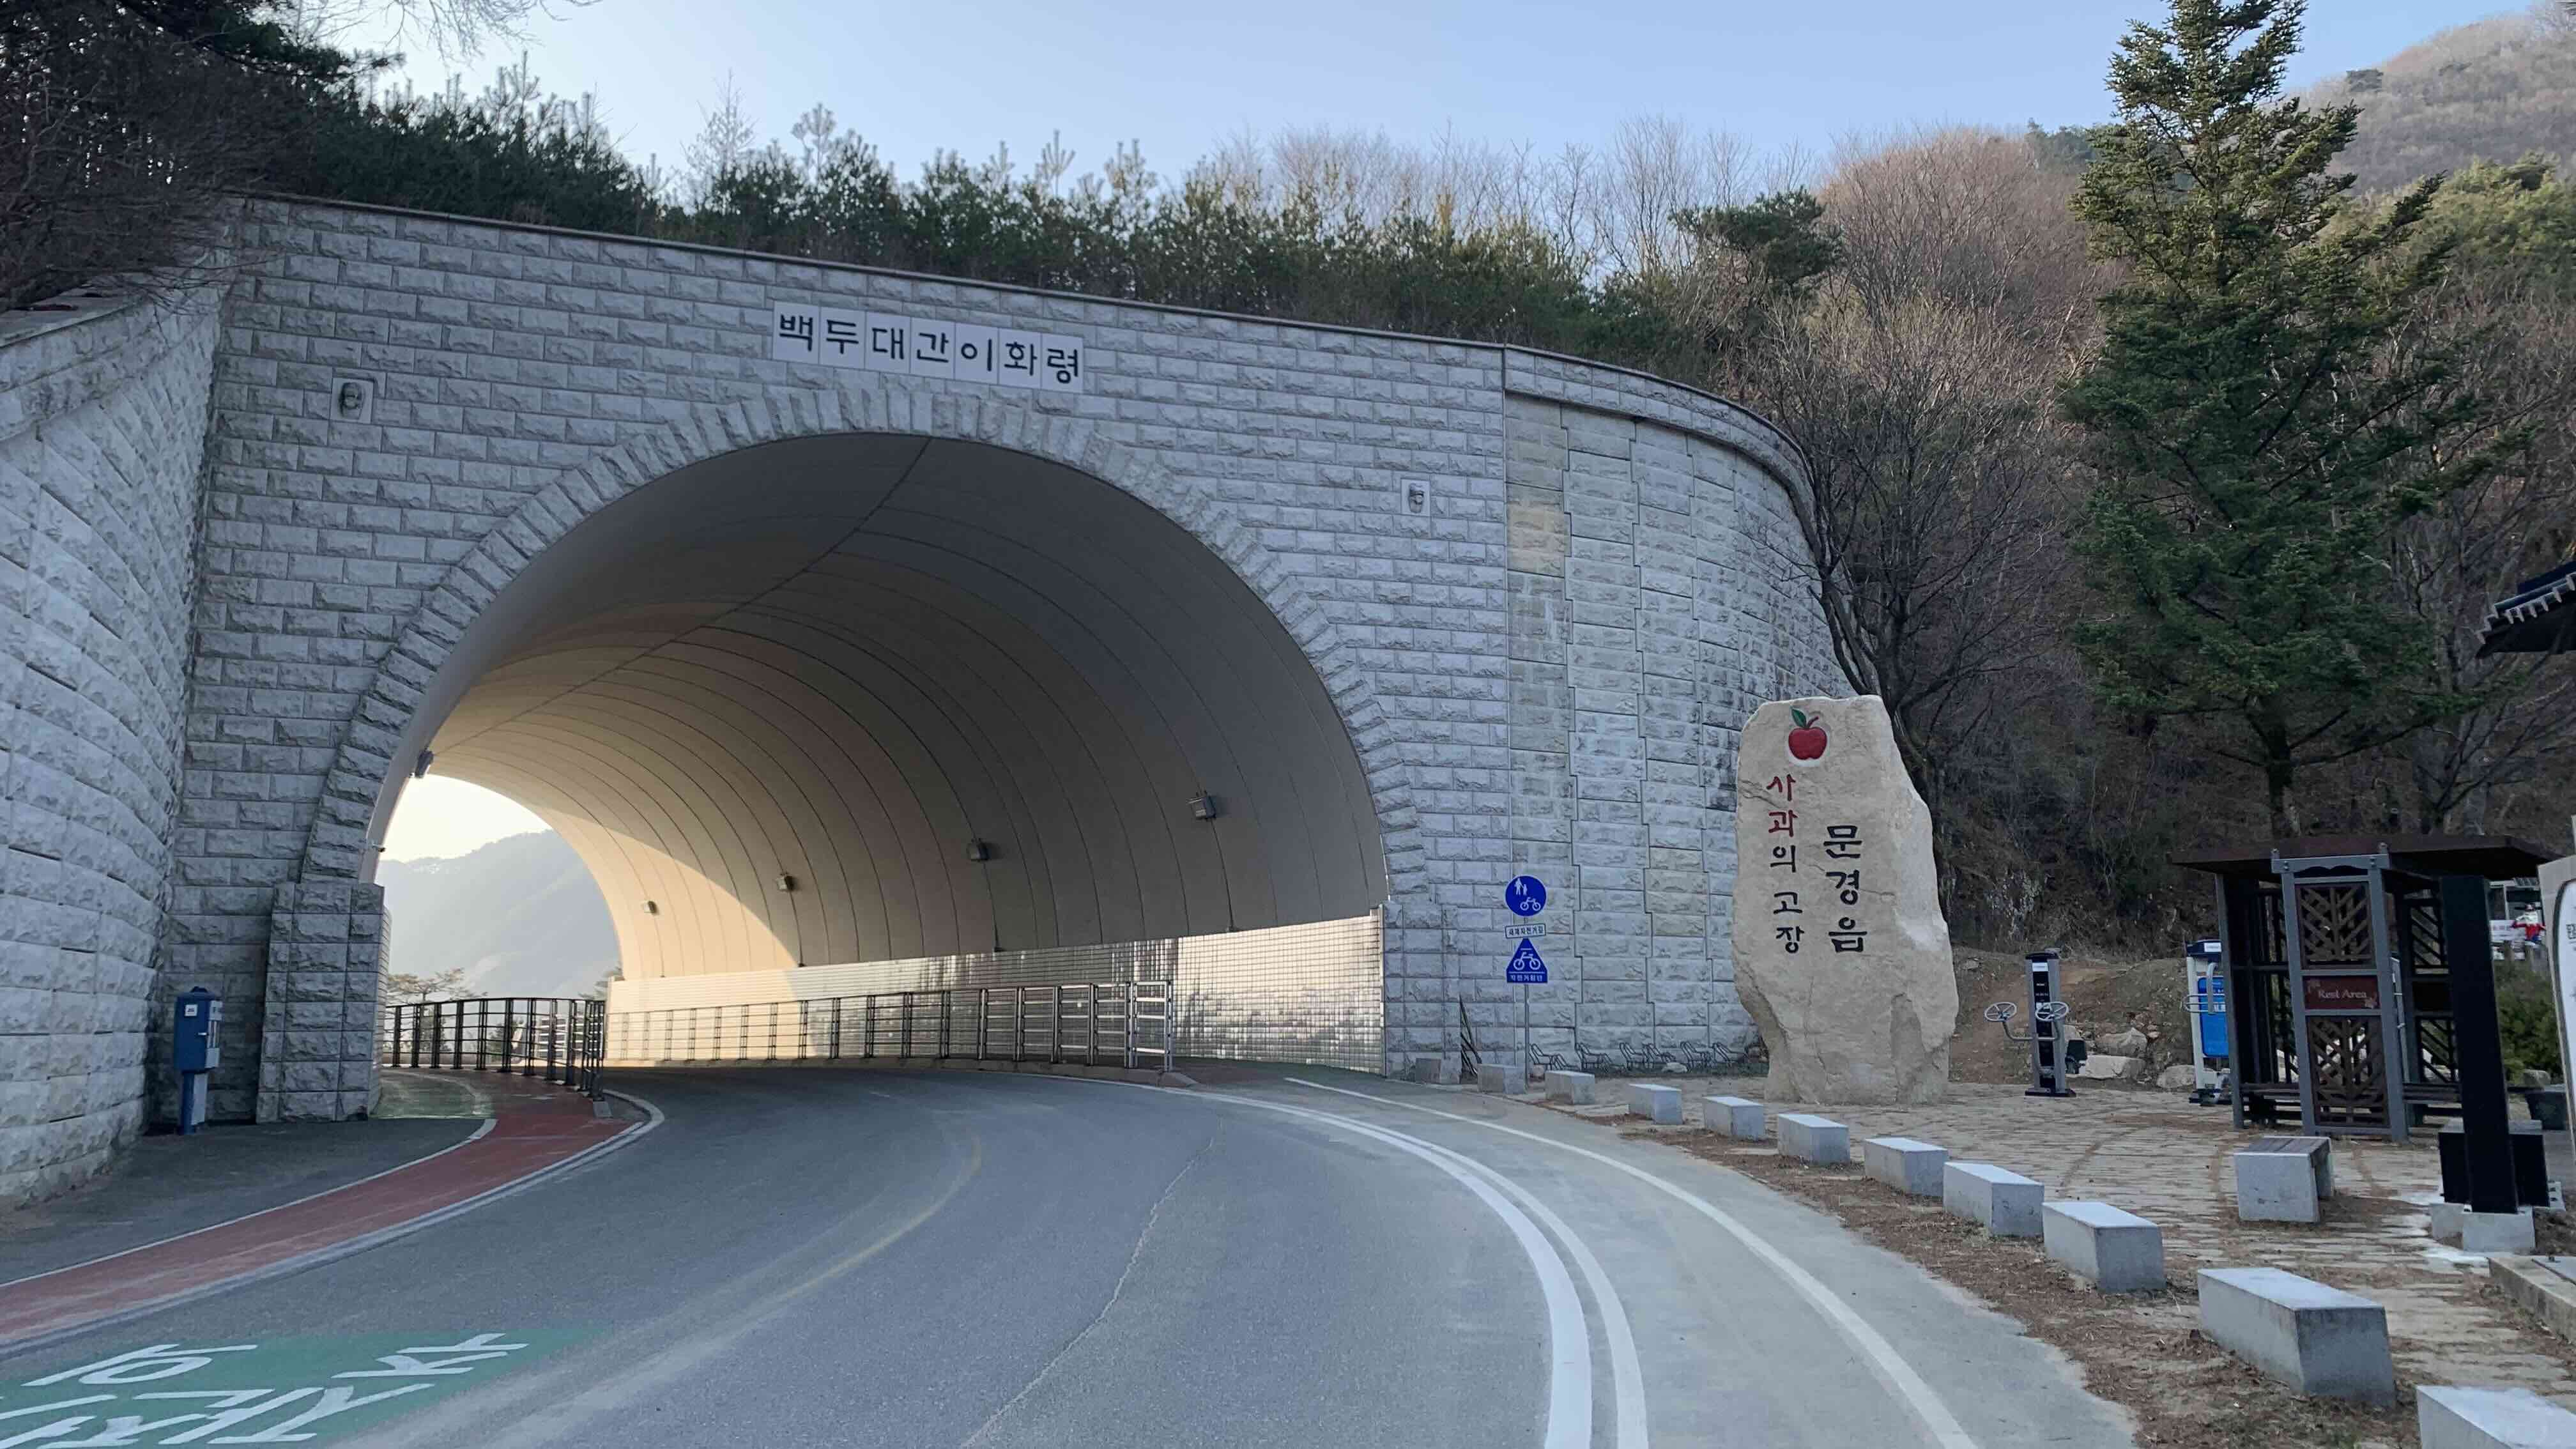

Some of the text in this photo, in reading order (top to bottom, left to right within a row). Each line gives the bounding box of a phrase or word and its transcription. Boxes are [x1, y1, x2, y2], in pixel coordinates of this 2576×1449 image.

[1766, 774, 1805, 954] 사과의 고장
[1823, 825, 1867, 953] 문경읍
[2318, 989, 2367, 999] Rest Area
